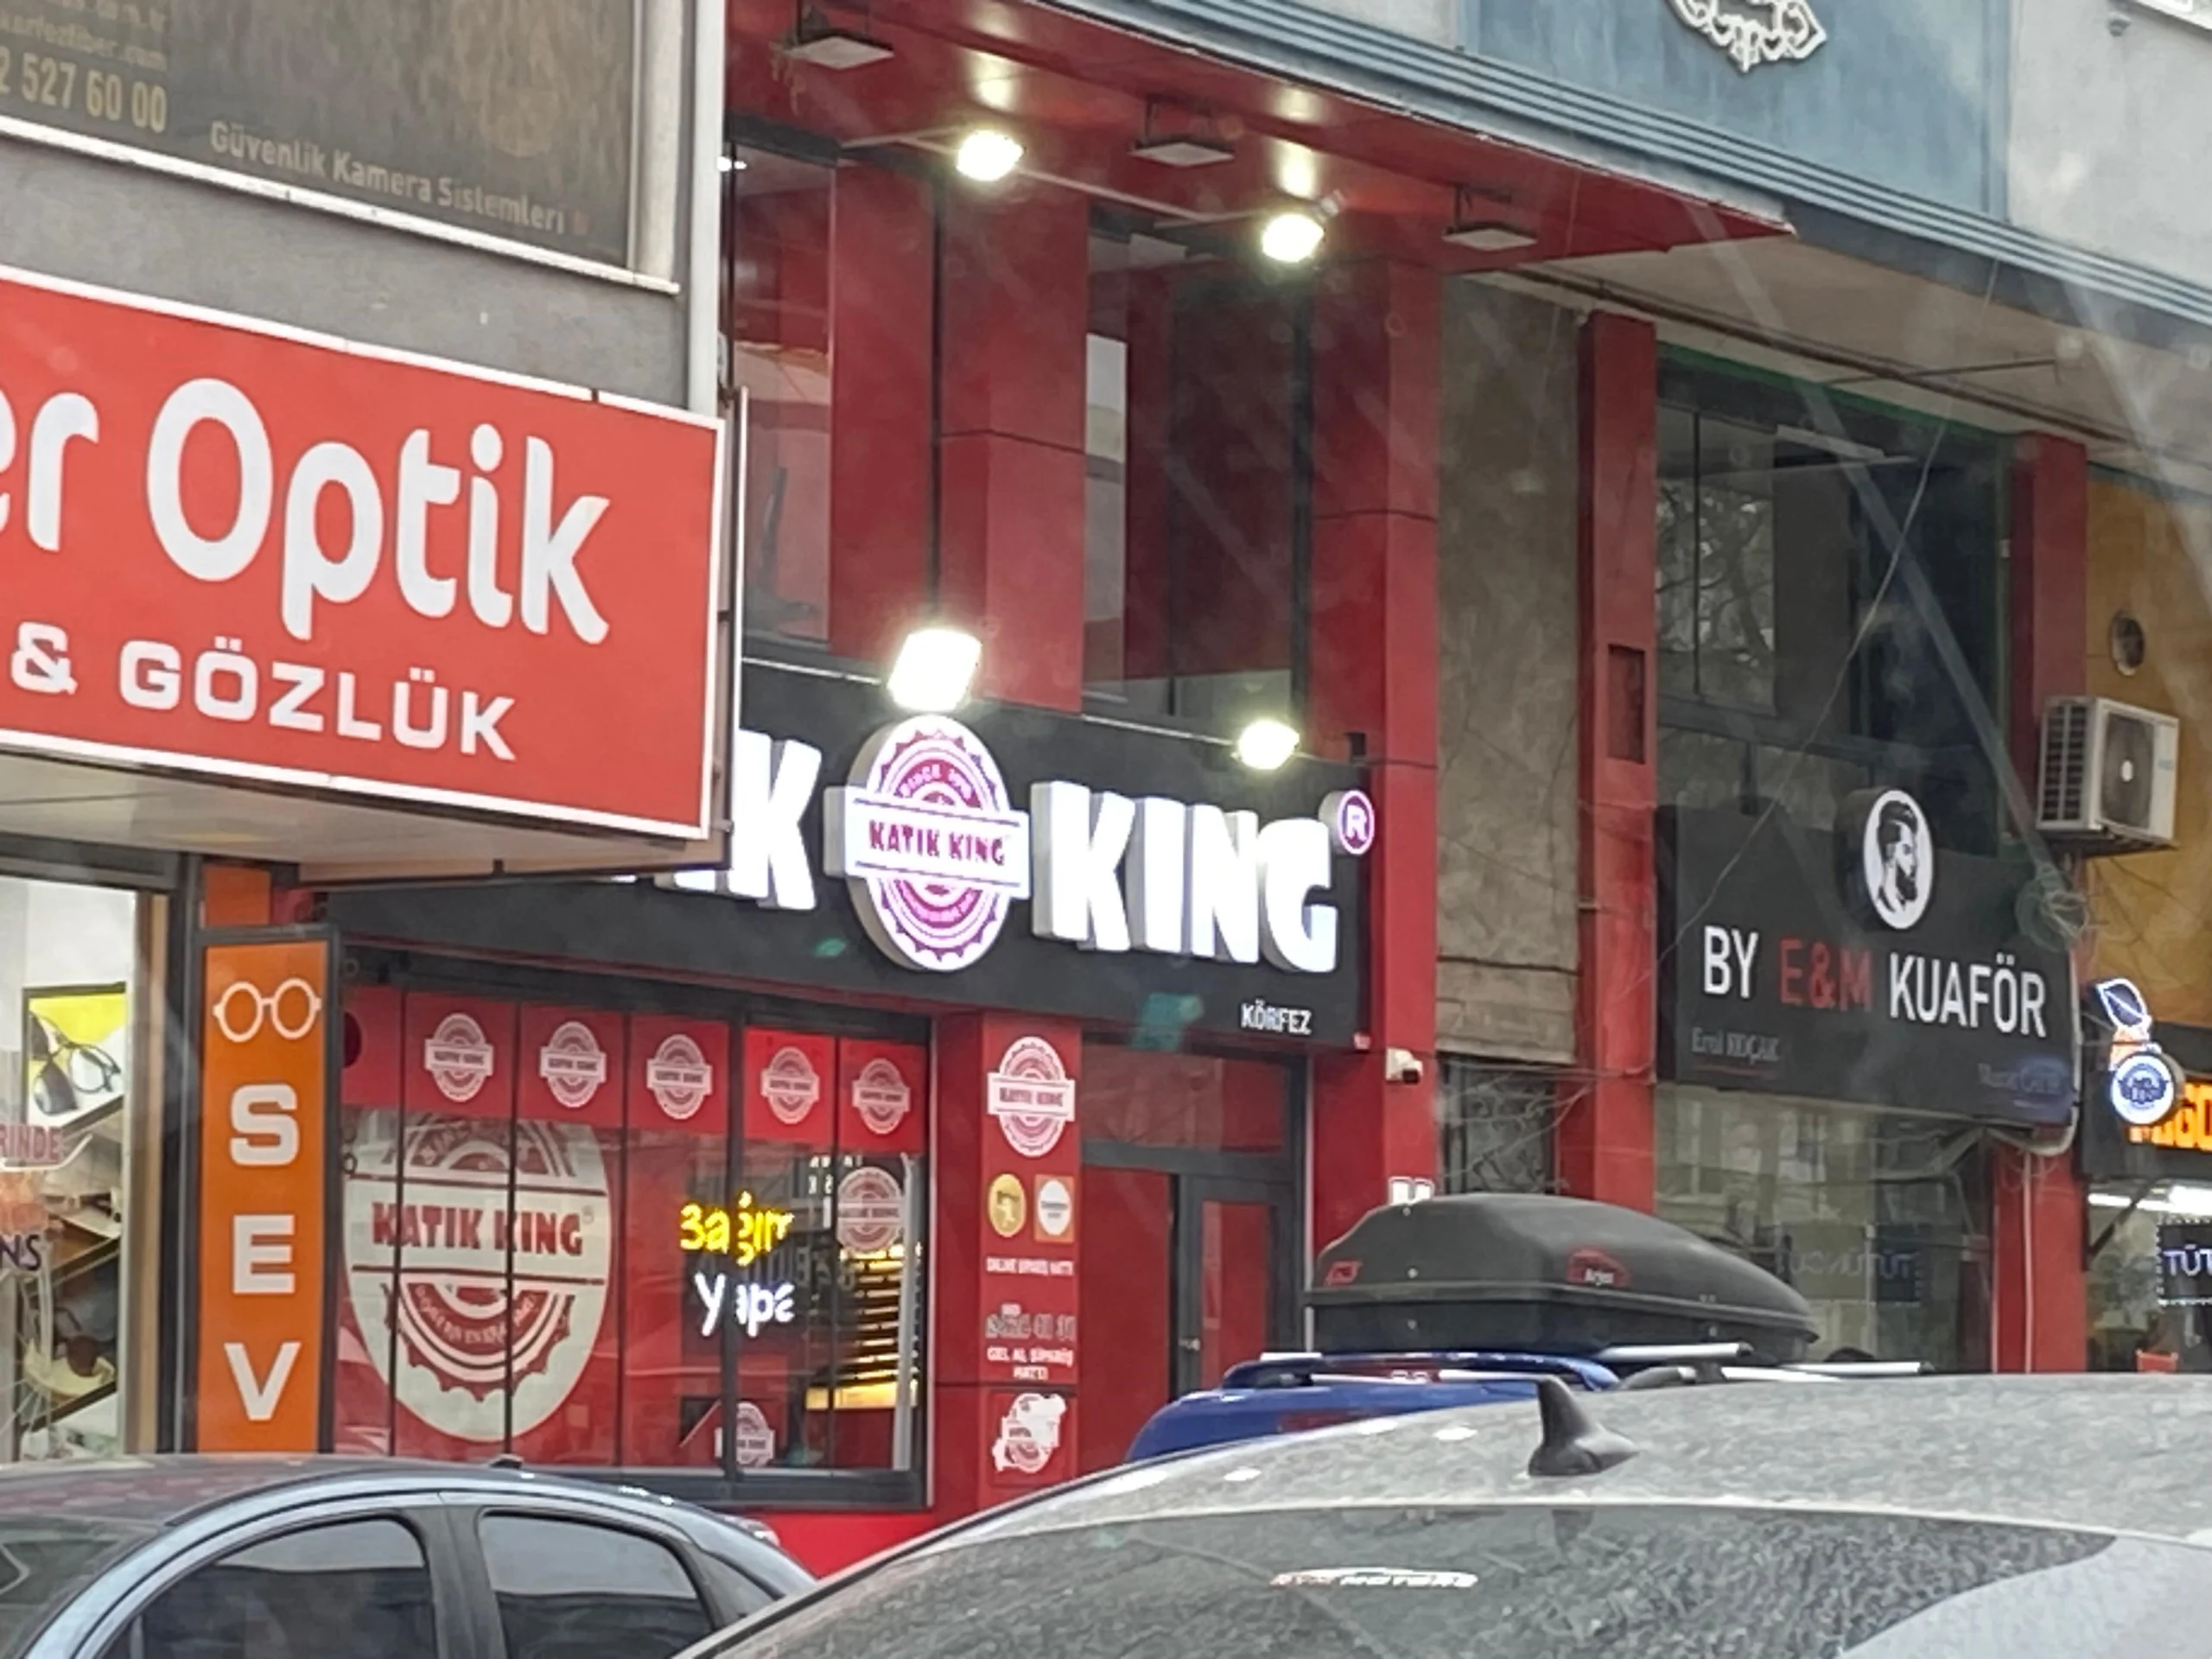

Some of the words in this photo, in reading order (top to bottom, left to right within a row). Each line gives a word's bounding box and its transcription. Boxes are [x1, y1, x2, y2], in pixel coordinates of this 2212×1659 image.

[22, 52, 77, 110] 527
[86, 69, 122, 121] 60
[131, 81, 167, 133] 00
[210, 119, 326, 178] Güvenlik
[332, 149, 431, 203] Kamera
[437, 177, 566, 235] Sistemleri
[146, 377, 610, 644] Optik
[11, 622, 77, 695] &
[119, 636, 516, 761] GÖZLÜK
[868, 819, 940, 857] KATIK
[948, 831, 1004, 866] KING
[1033, 781, 1338, 973] KING
[1240, 1000, 1312, 1036] KÖRFEZ
[1703, 925, 1759, 998] BY
[1778, 937, 1872, 1012] E&M
[1889, 952, 2046, 1037] KUAFÖR
[372, 1201, 484, 1249] KATIK
